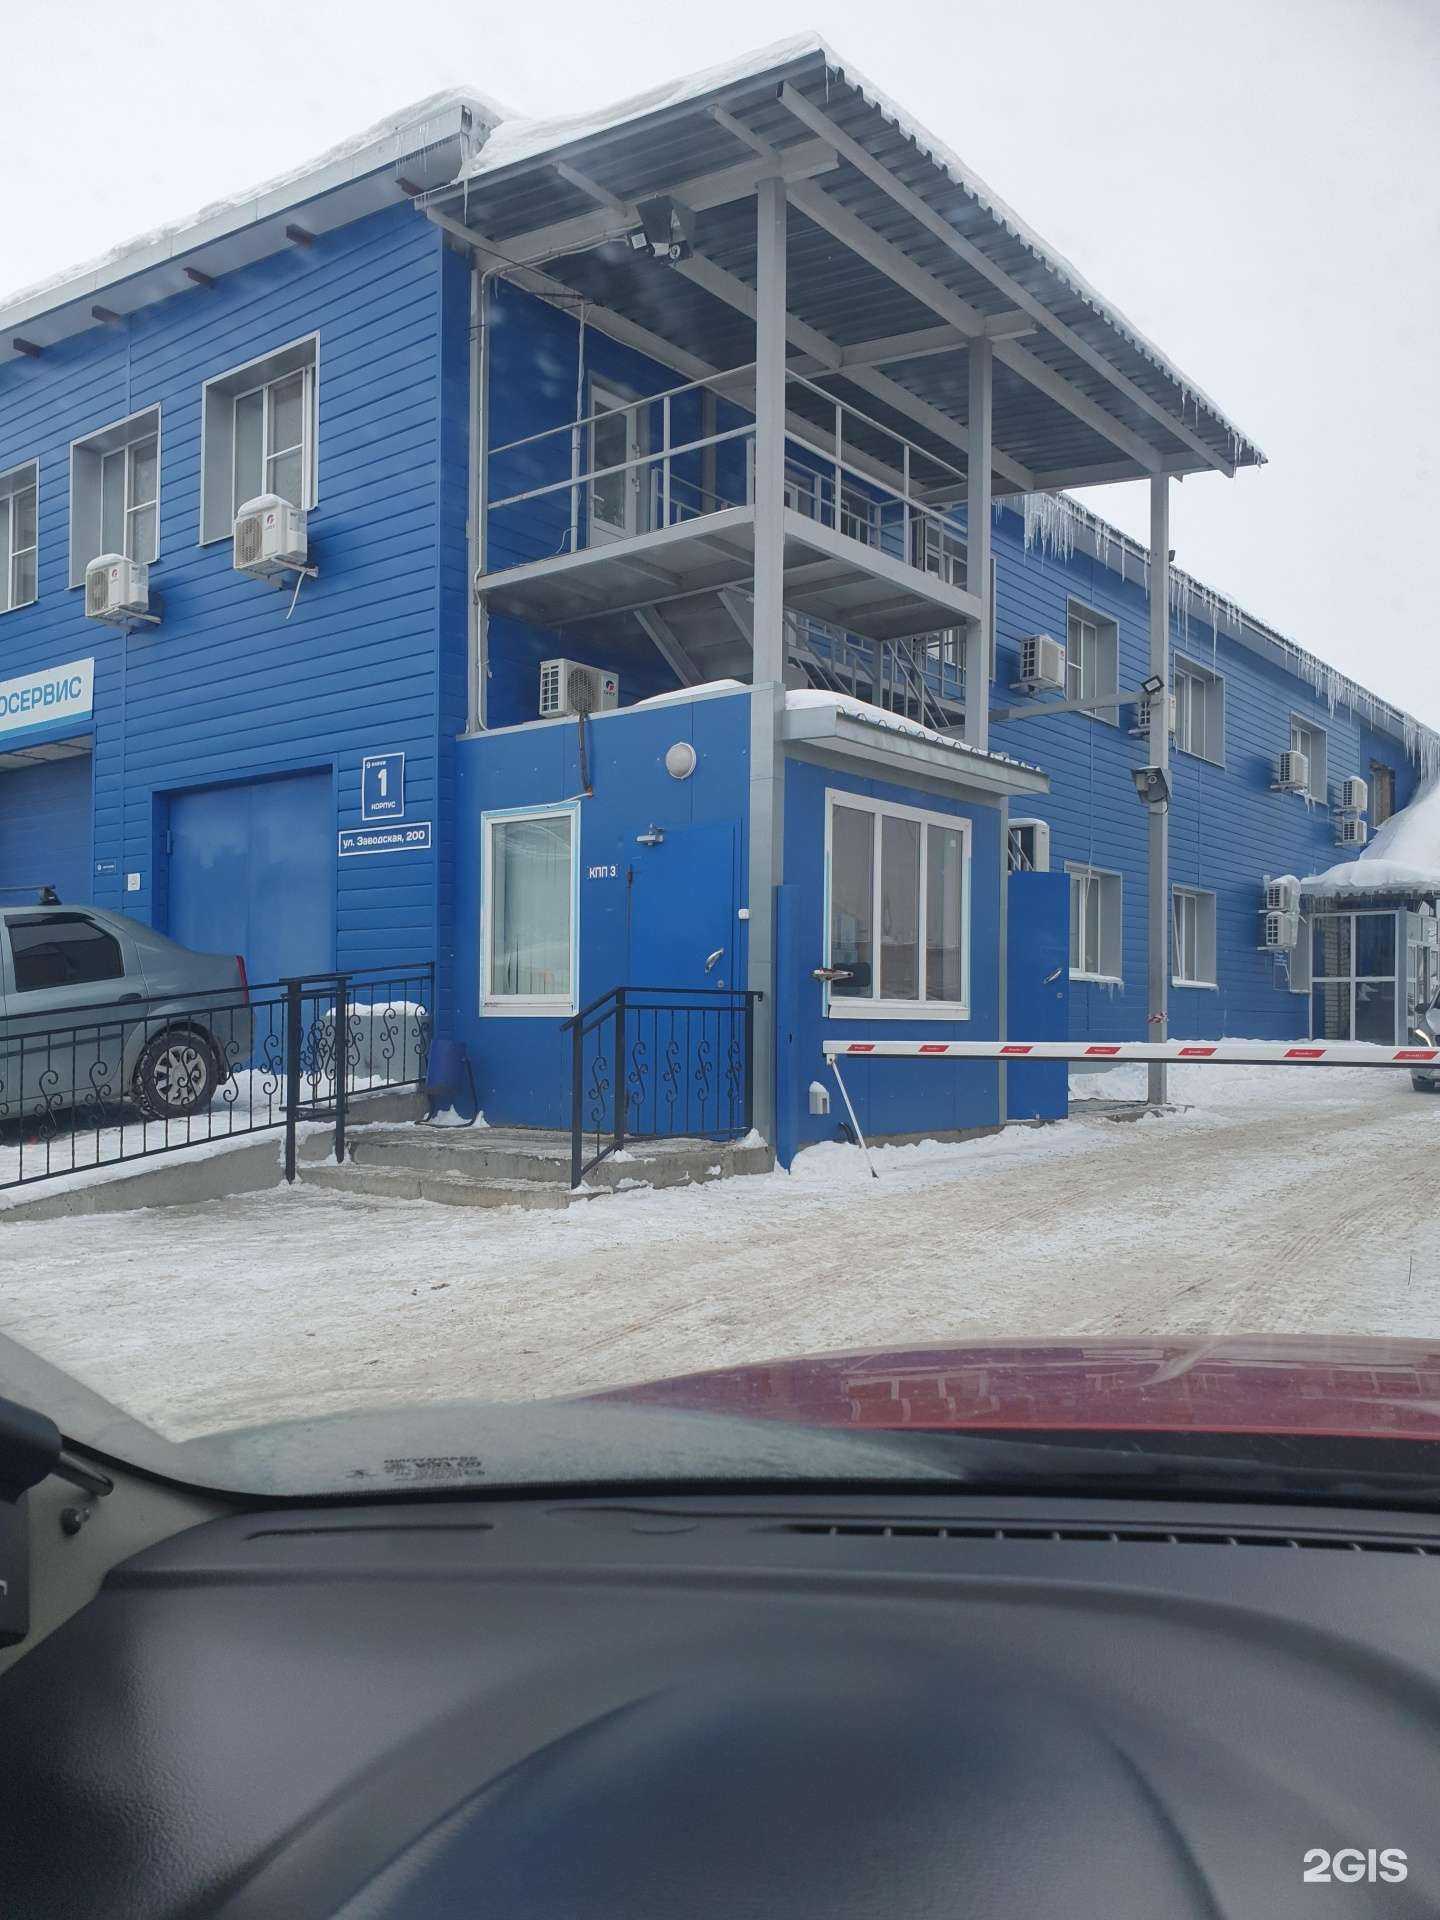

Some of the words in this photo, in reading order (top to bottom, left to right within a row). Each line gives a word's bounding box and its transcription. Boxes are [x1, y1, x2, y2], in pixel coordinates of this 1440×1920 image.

[378, 768, 387, 796] 1
[343, 839, 355, 849] ул.
[357, 834, 404, 846] Заводская,
[406, 831, 425, 841] 200
[589, 866, 608, 878] КПП
[610, 866, 617, 876] 3
